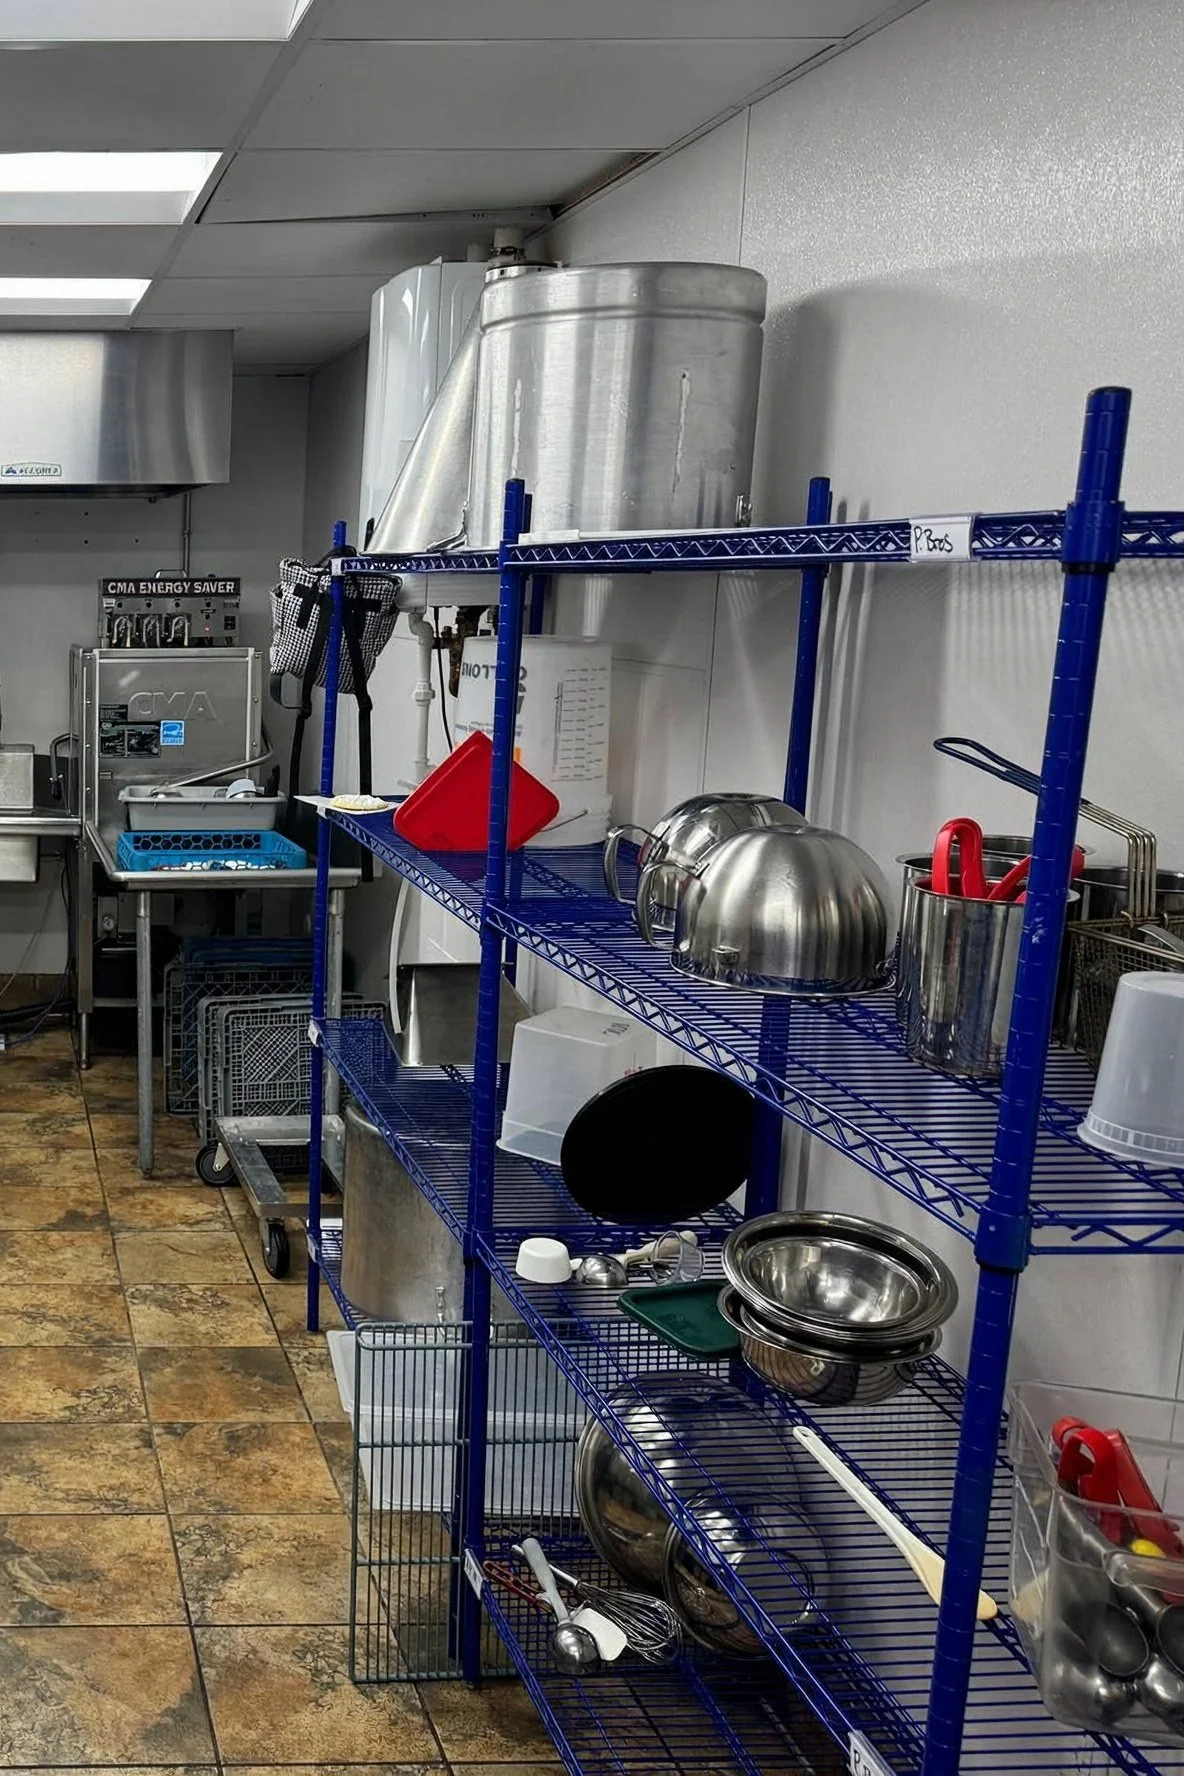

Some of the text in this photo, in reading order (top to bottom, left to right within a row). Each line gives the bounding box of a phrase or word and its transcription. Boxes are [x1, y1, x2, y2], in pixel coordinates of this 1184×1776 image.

[107, 581, 235, 594] CMA ENERGY SAVER
[128, 691, 218, 720] CMA
